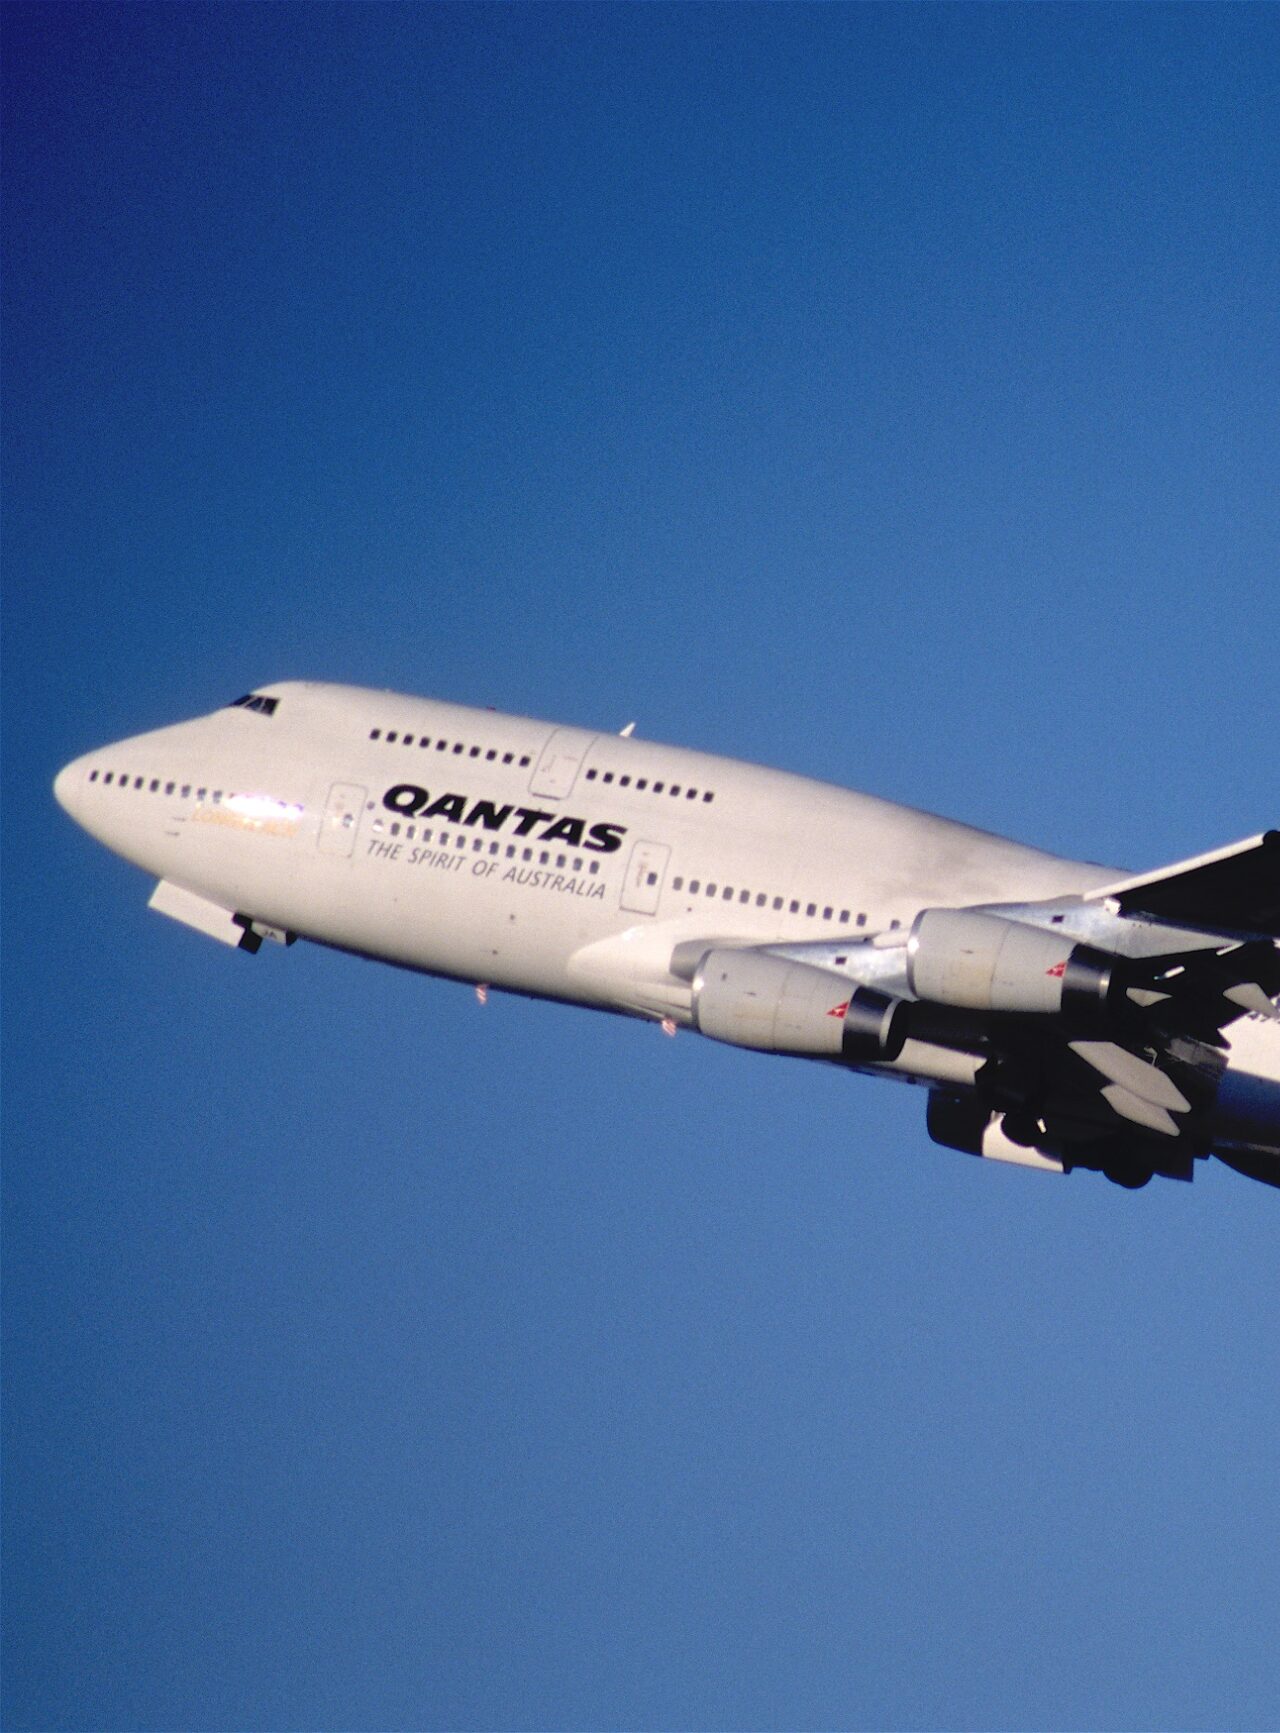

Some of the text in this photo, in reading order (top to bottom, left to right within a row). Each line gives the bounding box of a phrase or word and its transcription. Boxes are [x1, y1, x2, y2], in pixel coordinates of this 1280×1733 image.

[382, 783, 628, 854] QANTAS
[367, 839, 402, 861] THE
[408, 846, 467, 873] SPIRIT
[472, 859, 500, 879] OF
[503, 864, 607, 900] AUSTRALIA
